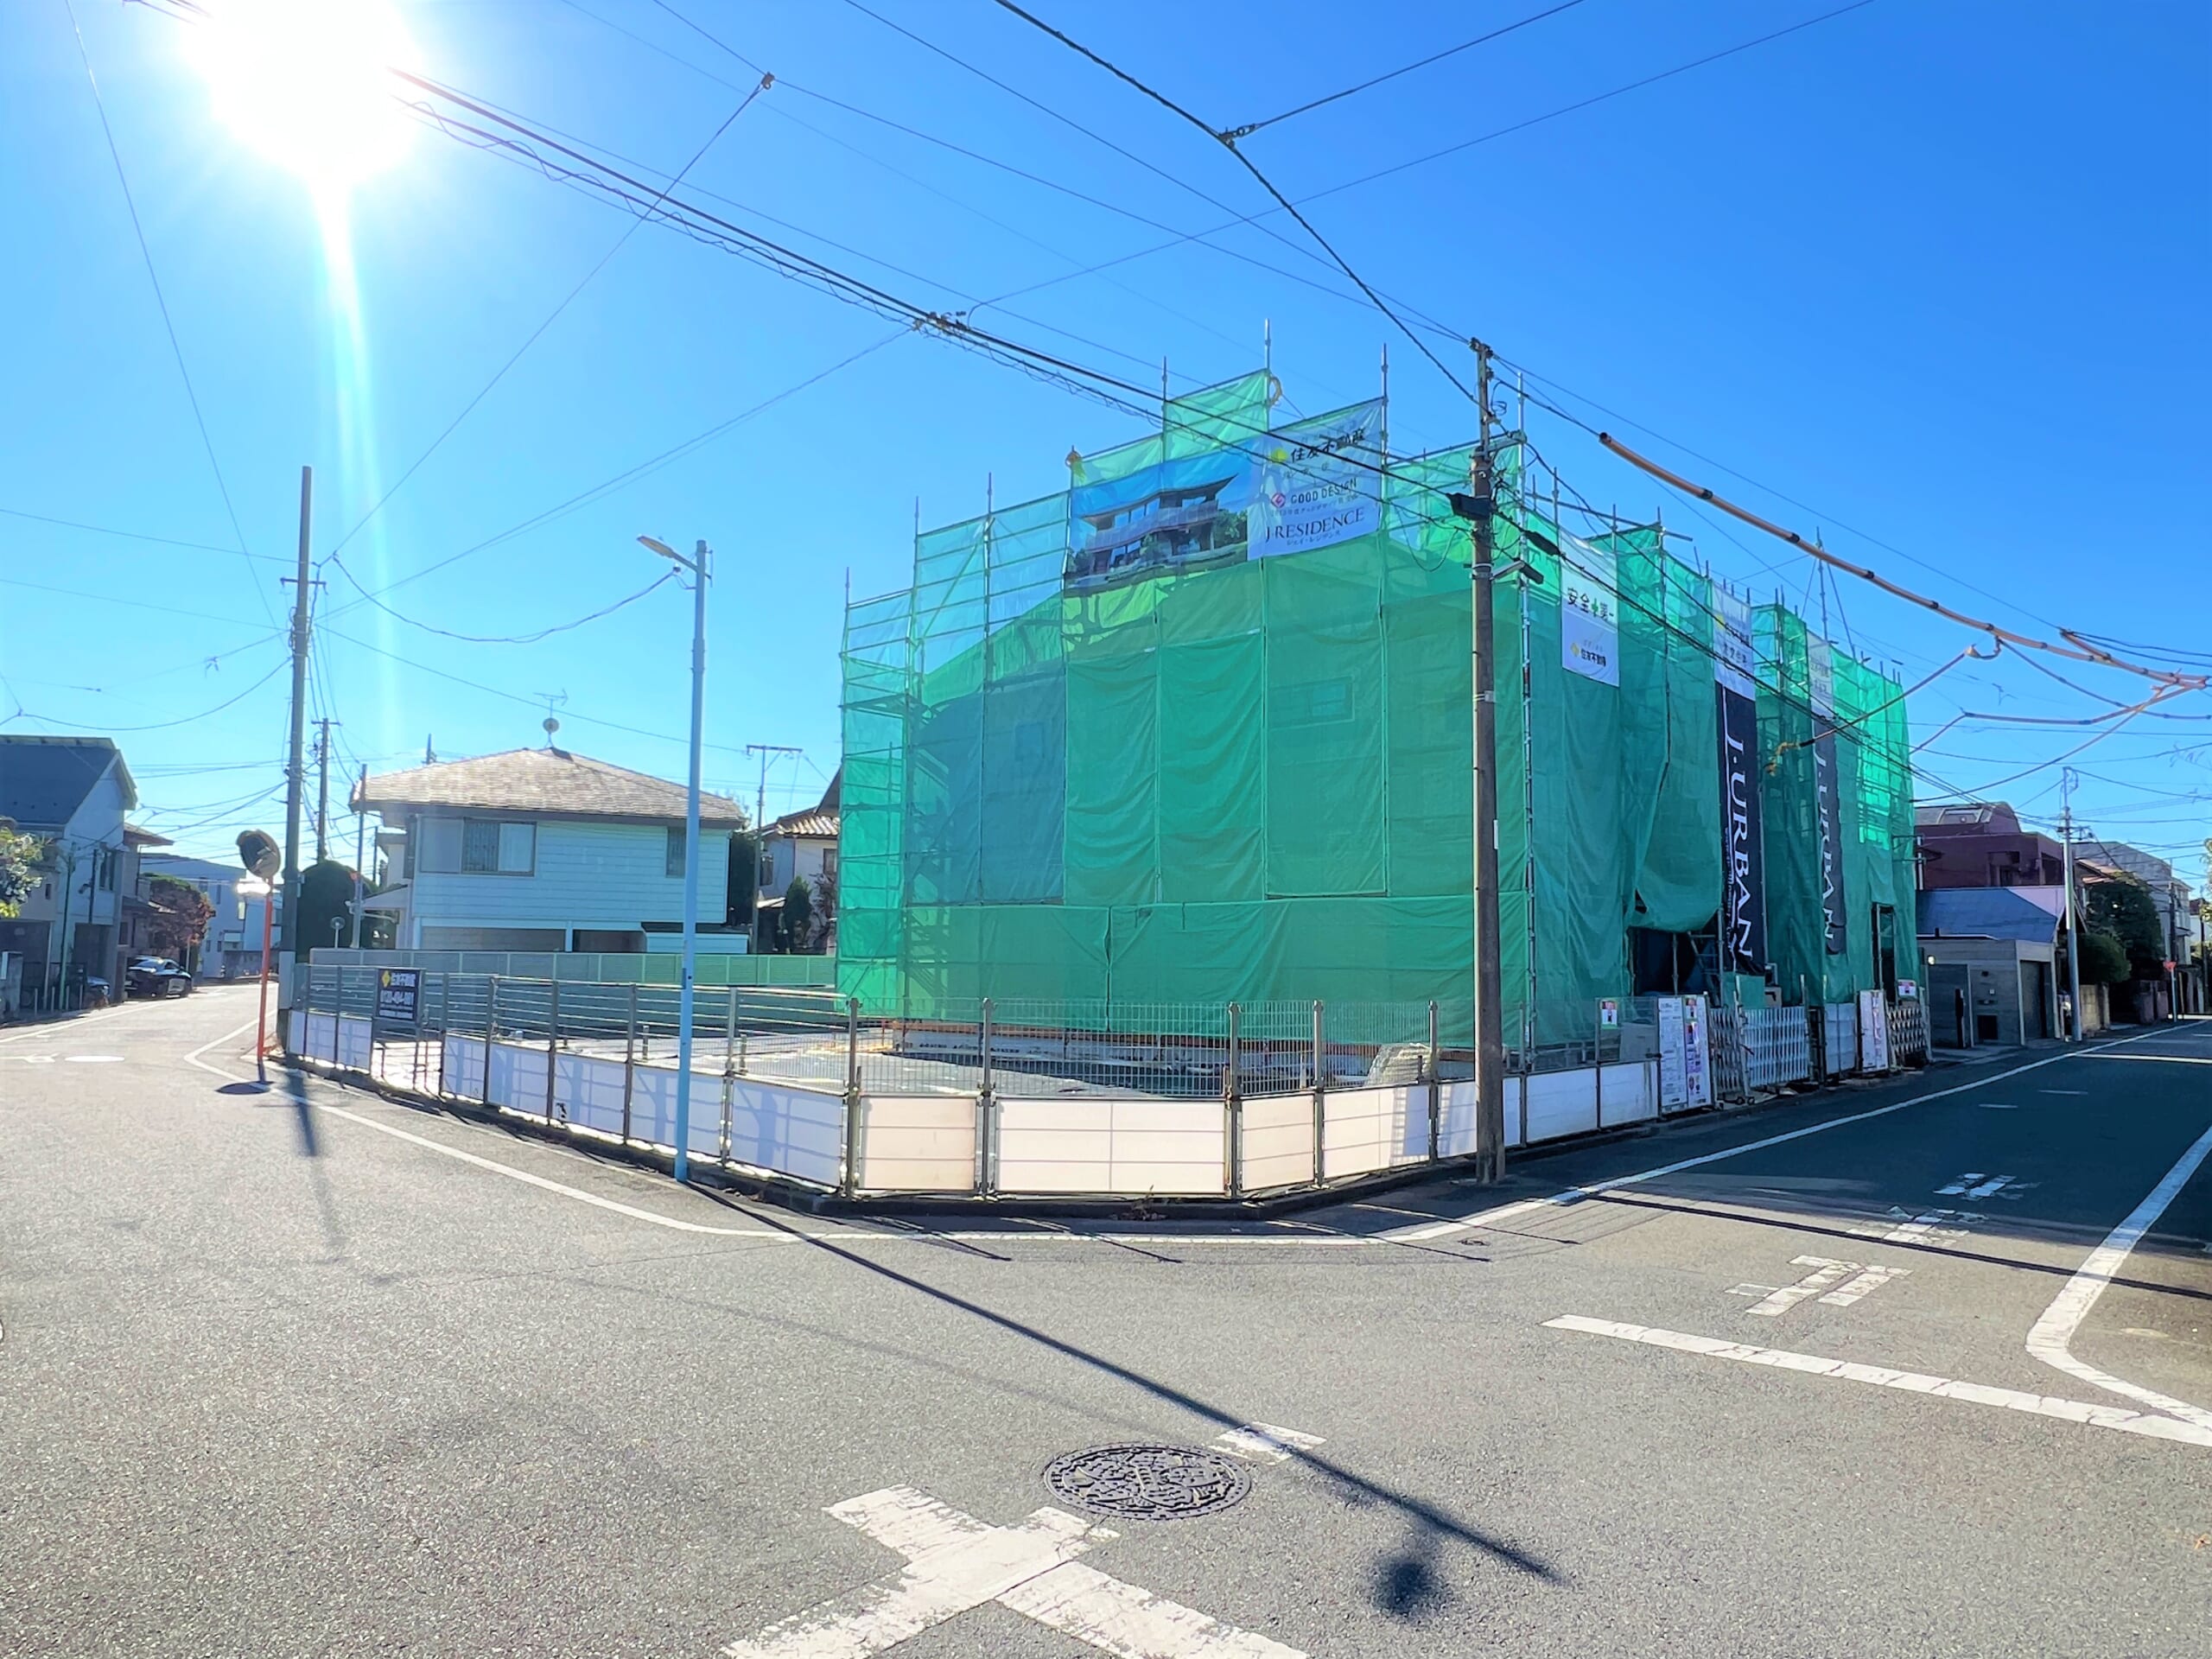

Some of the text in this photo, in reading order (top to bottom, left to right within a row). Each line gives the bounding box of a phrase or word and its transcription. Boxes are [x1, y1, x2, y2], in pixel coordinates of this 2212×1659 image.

[1291, 477, 1357, 505] GOOD DESIGN
[1274, 506, 1365, 539] RESIDENCE
